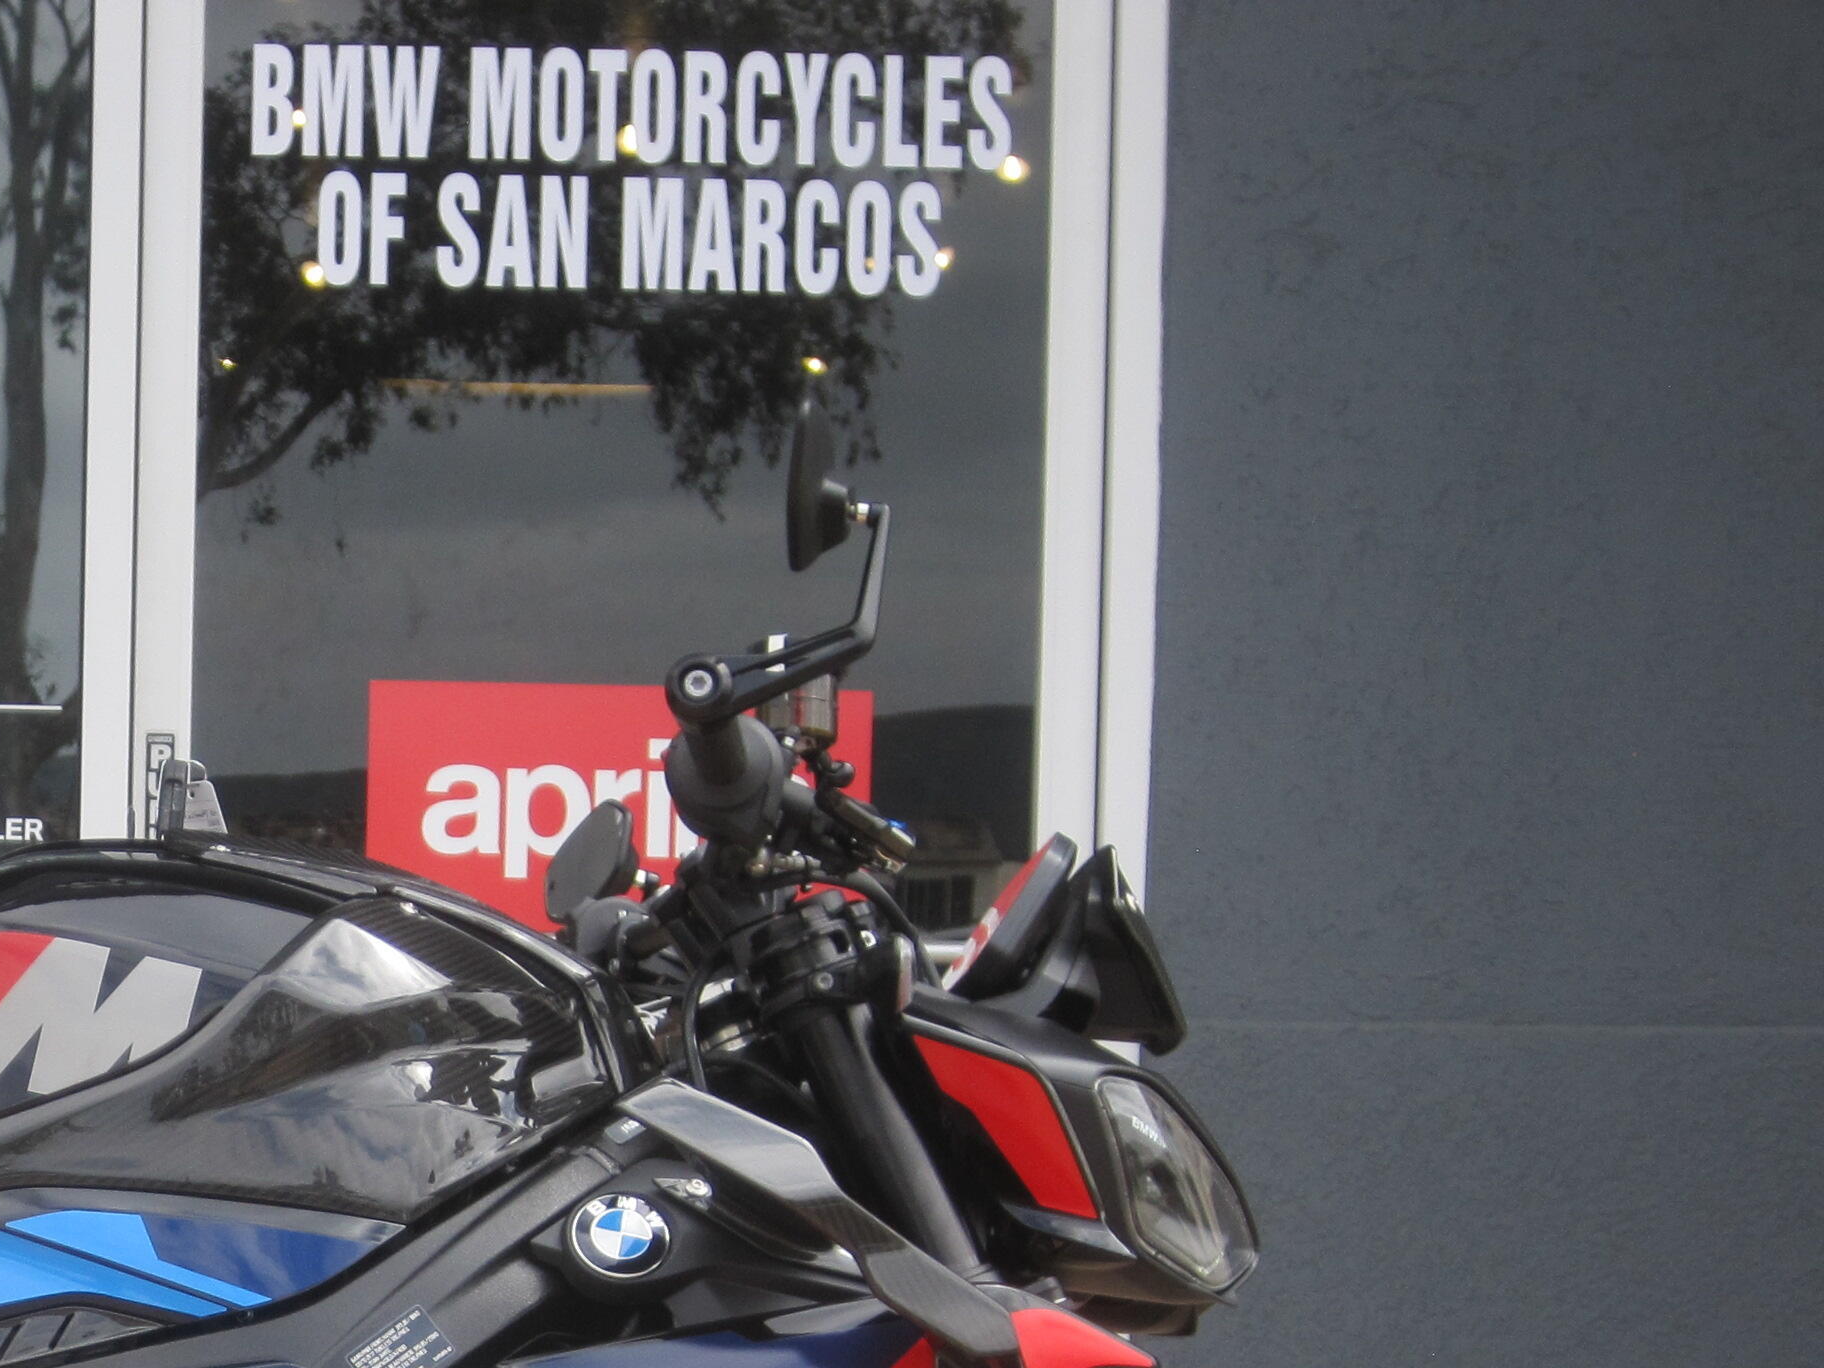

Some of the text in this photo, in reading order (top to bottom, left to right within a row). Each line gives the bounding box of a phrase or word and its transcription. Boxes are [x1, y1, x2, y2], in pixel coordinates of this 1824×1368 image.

[251, 43, 1014, 170] BMW MOTORCYCLES
[316, 171, 943, 298] OF SAN MARCOS
[421, 738, 704, 879] apri
[585, 1194, 665, 1228] BMW
